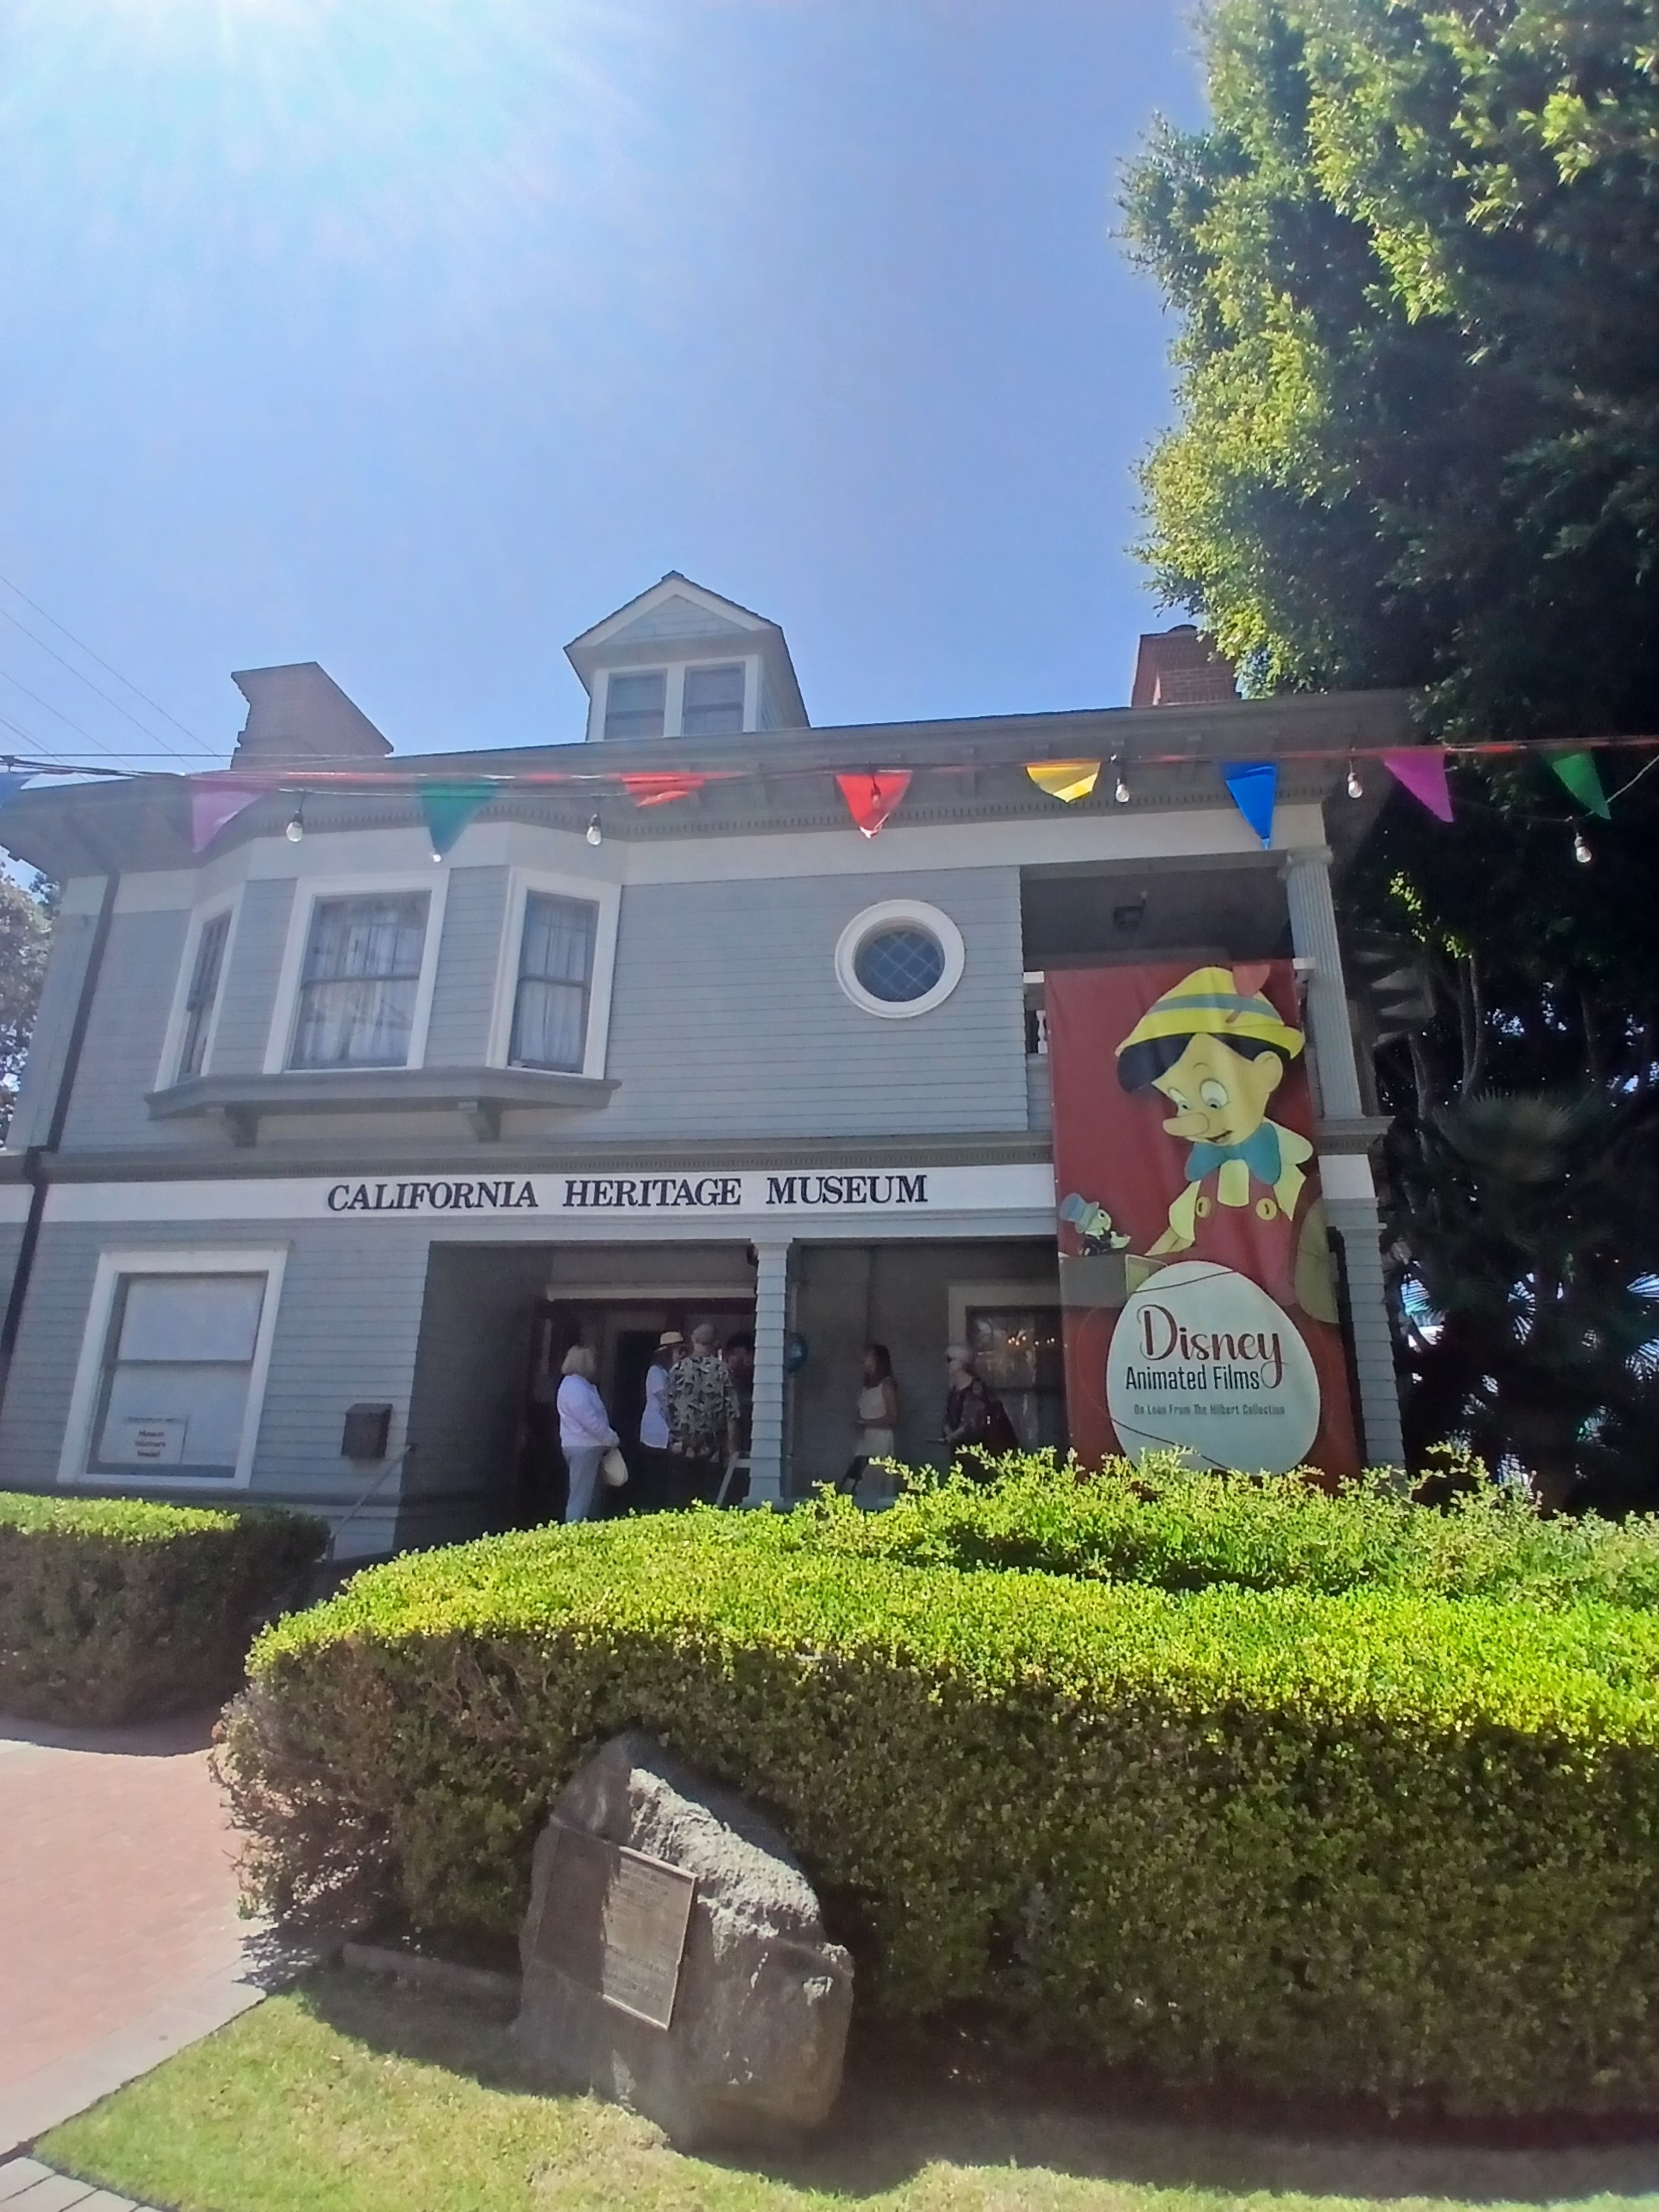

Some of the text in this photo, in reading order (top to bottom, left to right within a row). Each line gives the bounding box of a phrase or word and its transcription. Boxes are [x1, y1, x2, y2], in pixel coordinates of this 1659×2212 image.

[327, 1175, 928, 1211] CALIFORNIA HERITAGE MUSEUM
[1137, 1304, 1289, 1389] Disney
[1125, 1364, 1260, 1390] Animated Films
[1134, 1404, 1144, 1415] On
[1147, 1404, 1166, 1415] Loan
[1169, 1404, 1190, 1415] From
[1193, 1403, 1207, 1415] The
[1242, 1403, 1285, 1415] Collection
